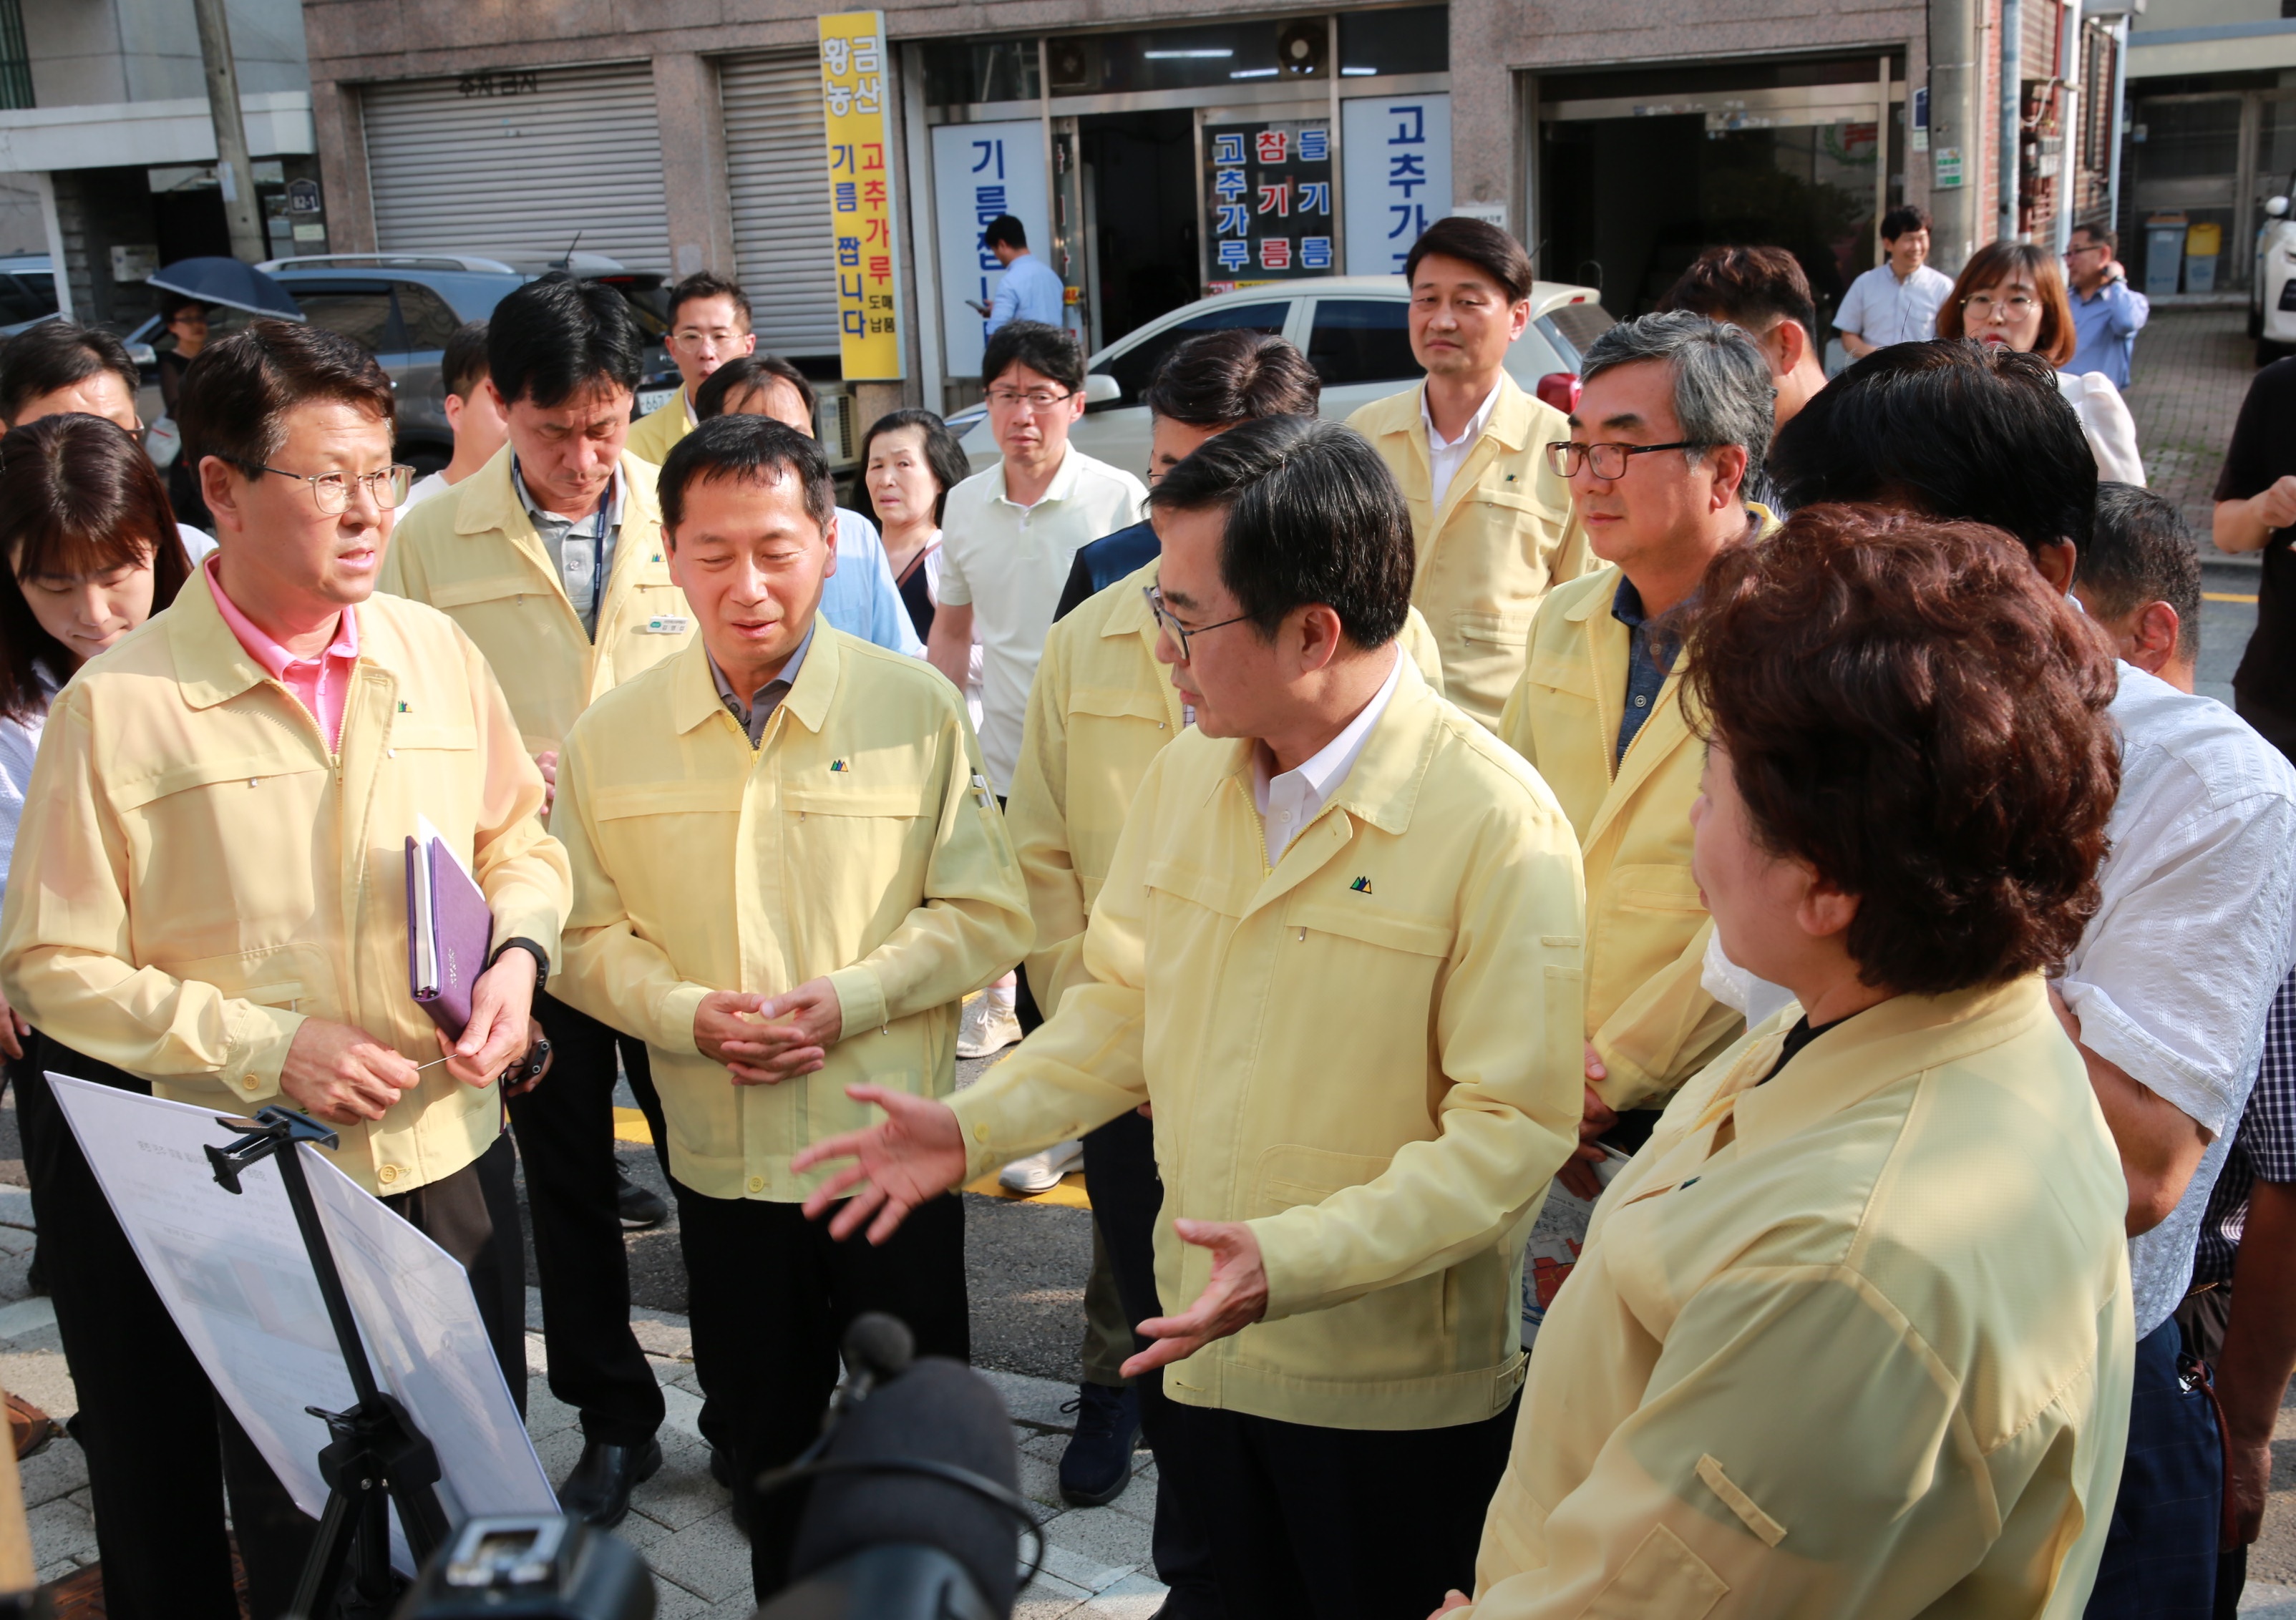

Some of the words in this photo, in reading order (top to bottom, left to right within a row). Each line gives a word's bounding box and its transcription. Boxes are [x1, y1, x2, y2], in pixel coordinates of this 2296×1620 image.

[822, 36, 879, 77] 황금
[826, 77, 881, 117] 농산
[832, 145, 857, 212] 기름
[862, 143, 891, 286] 고추가루
[1215, 133, 1250, 272] 고추가루
[1256, 130, 1291, 270] 참기름
[1298, 128, 1332, 268] 들기름
[1388, 106, 1429, 275] 고추가
[837, 237, 866, 338] 짭니다
[869, 295, 893, 311] 도매
[870, 317, 895, 333] 납품
